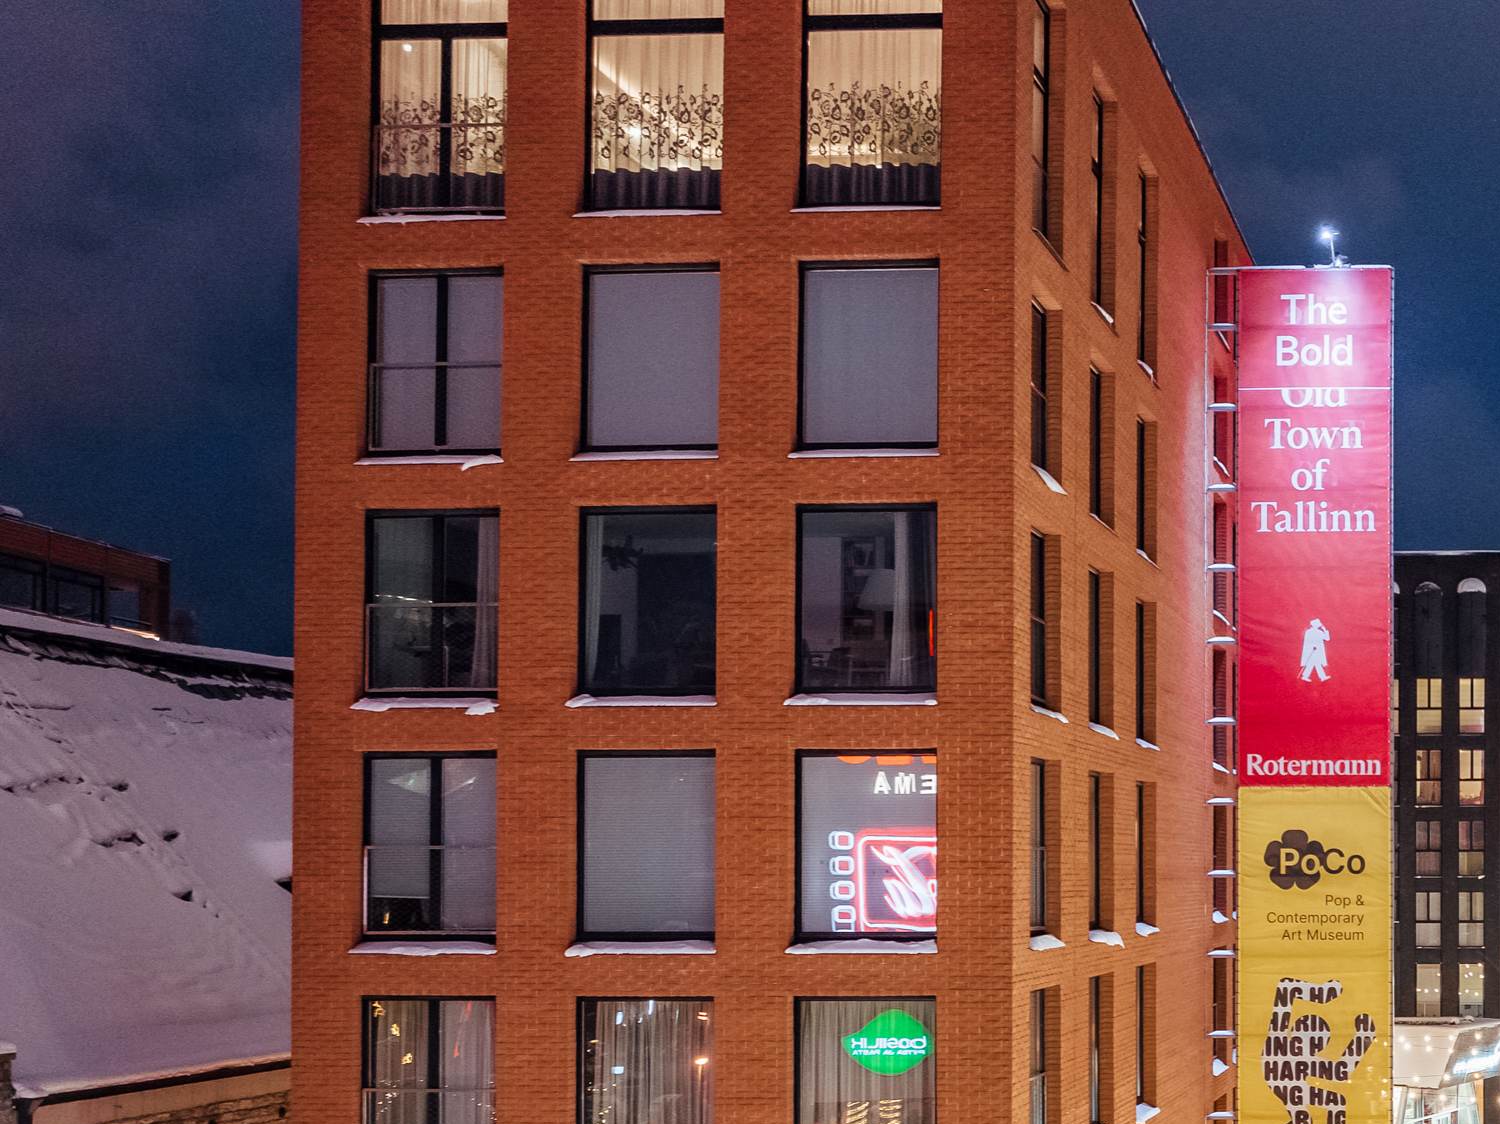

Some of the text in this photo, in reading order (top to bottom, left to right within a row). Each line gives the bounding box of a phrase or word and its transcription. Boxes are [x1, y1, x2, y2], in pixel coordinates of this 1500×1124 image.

[1281, 293, 1348, 325] The
[1275, 334, 1353, 366] Bold
[1264, 418, 1364, 449] Town
[1291, 458, 1331, 491] of
[1251, 501, 1376, 533] Tallinn
[1246, 753, 1382, 776] Rotermann
[1279, 847, 1366, 875] PoCo
[1325, 894, 1365, 908] Pop &
[1266, 911, 1365, 927] Contemporary
[1281, 929, 1365, 941] Art Museum
[1264, 1061, 1348, 1081] HARING
